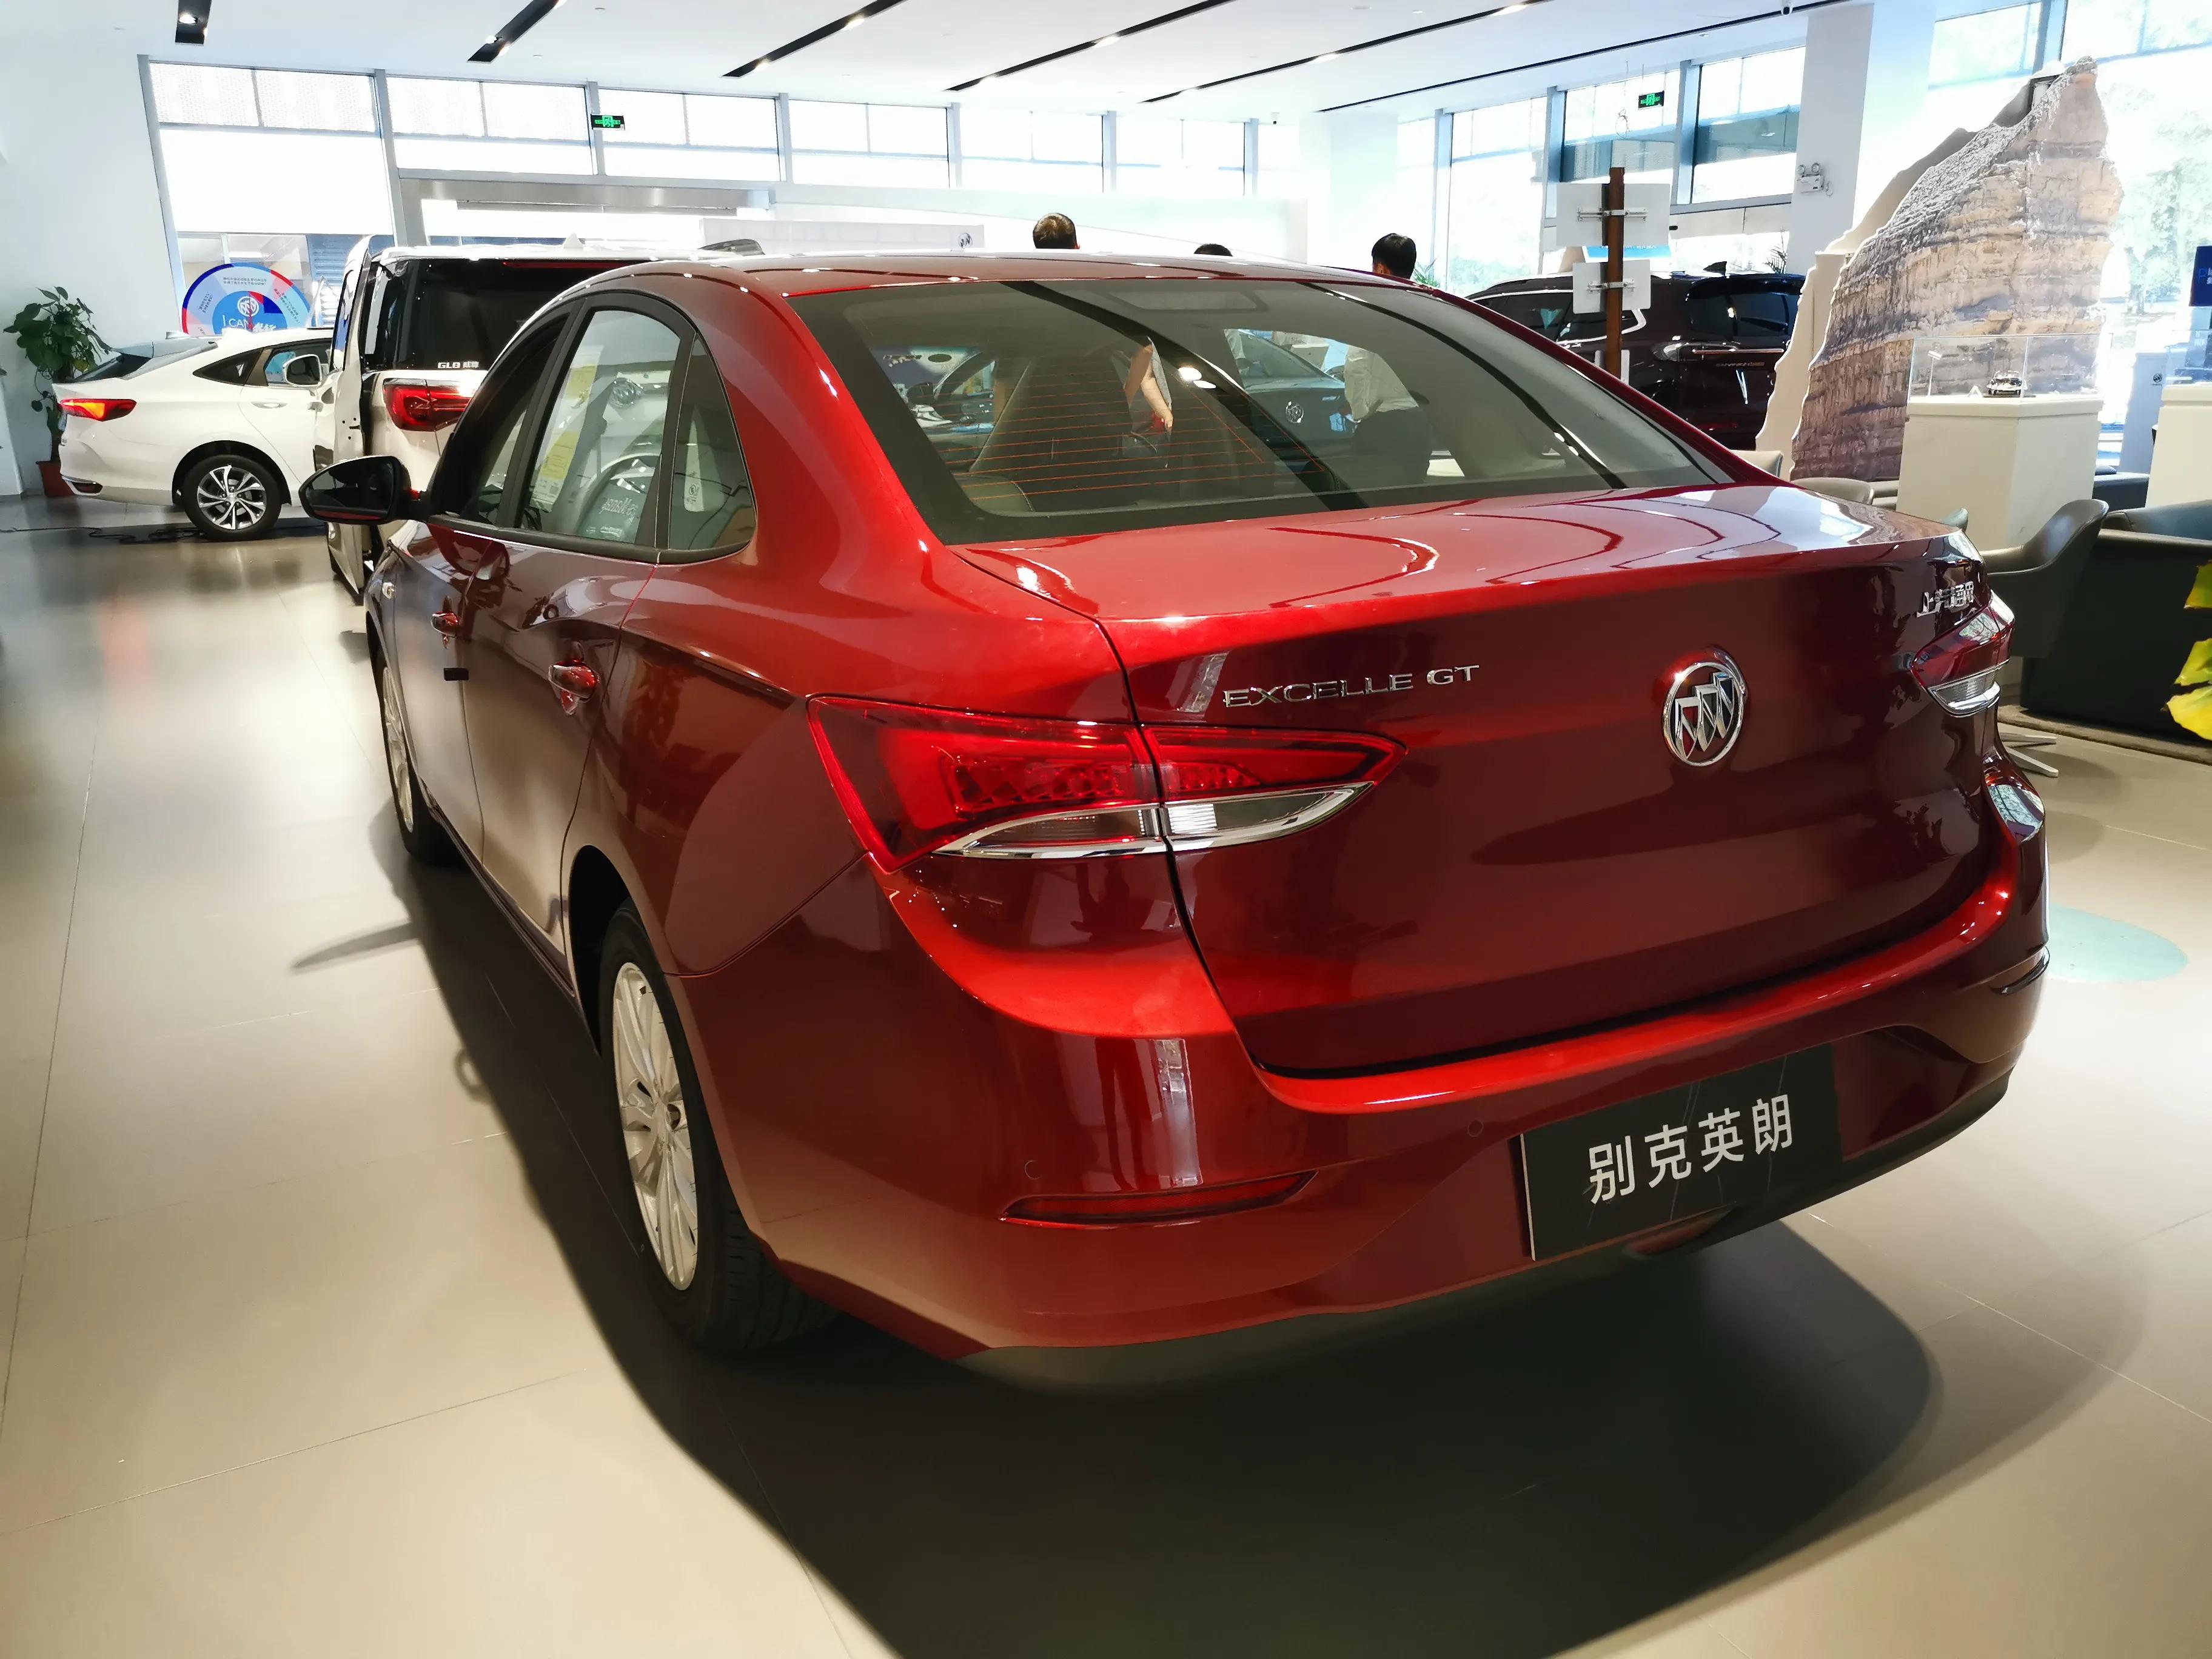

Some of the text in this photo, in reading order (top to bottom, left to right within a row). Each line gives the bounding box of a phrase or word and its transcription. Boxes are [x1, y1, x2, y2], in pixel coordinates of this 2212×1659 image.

[1916, 581, 1974, 618] 上汽通用
[1222, 665, 1480, 708] EXCELLE GT
[1589, 1094, 1792, 1205] 别克英朗
